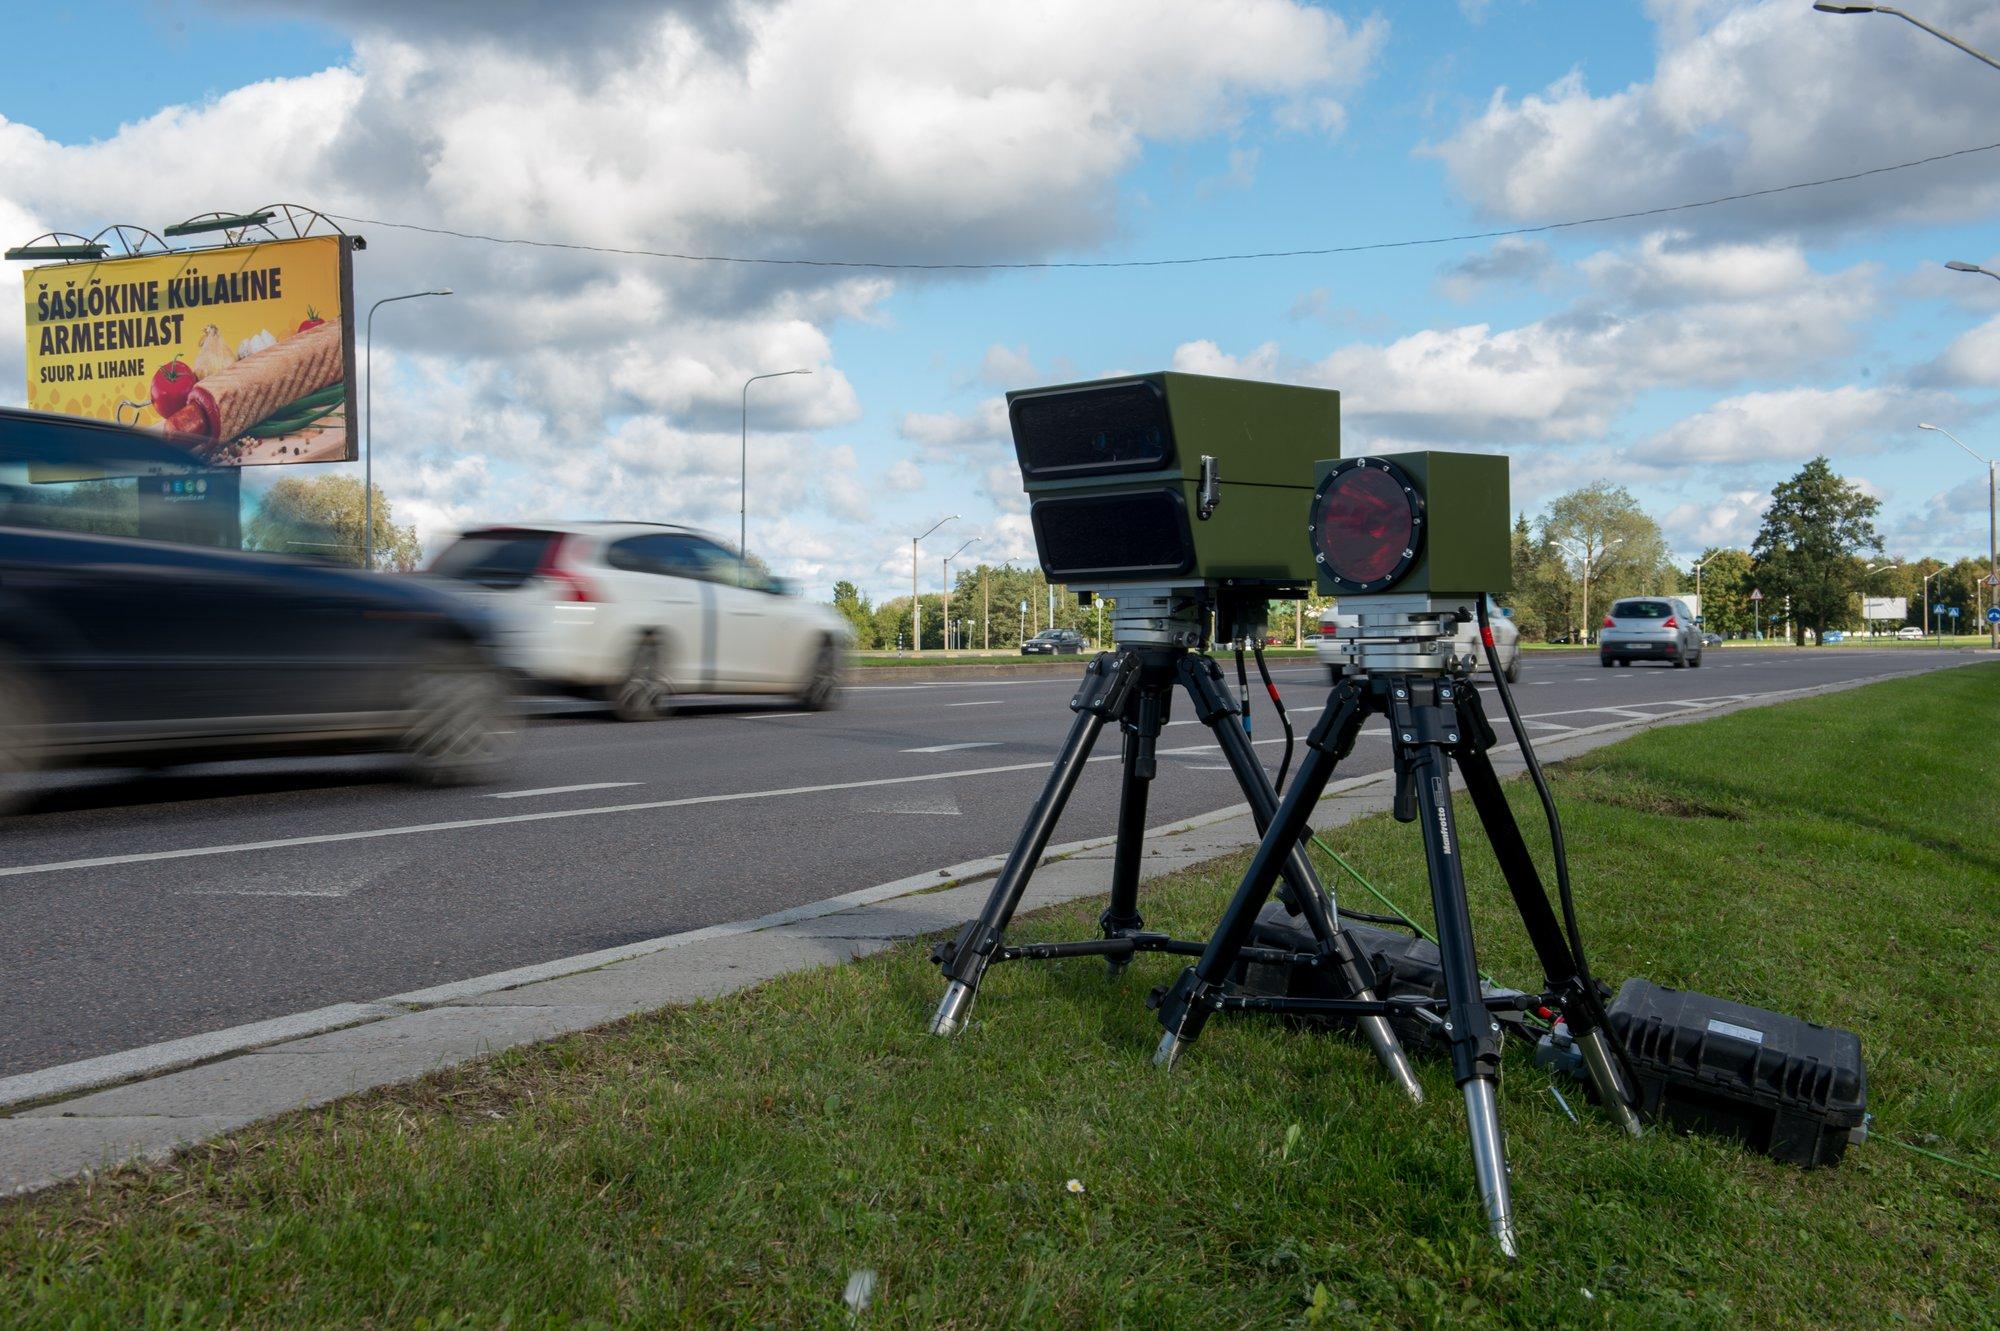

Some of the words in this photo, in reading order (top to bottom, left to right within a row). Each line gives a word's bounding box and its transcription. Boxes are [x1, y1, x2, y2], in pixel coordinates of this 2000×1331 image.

[38, 278, 159, 322] ŠAŠLÕKINE
[168, 267, 282, 309] KÜLALINE
[39, 314, 184, 356] ARMEENIAST
[40, 364, 75, 383] SUUR
[78, 363, 93, 380] JA
[98, 358, 145, 379] LIHANE
[1438, 807, 1451, 854] Manfrotto
